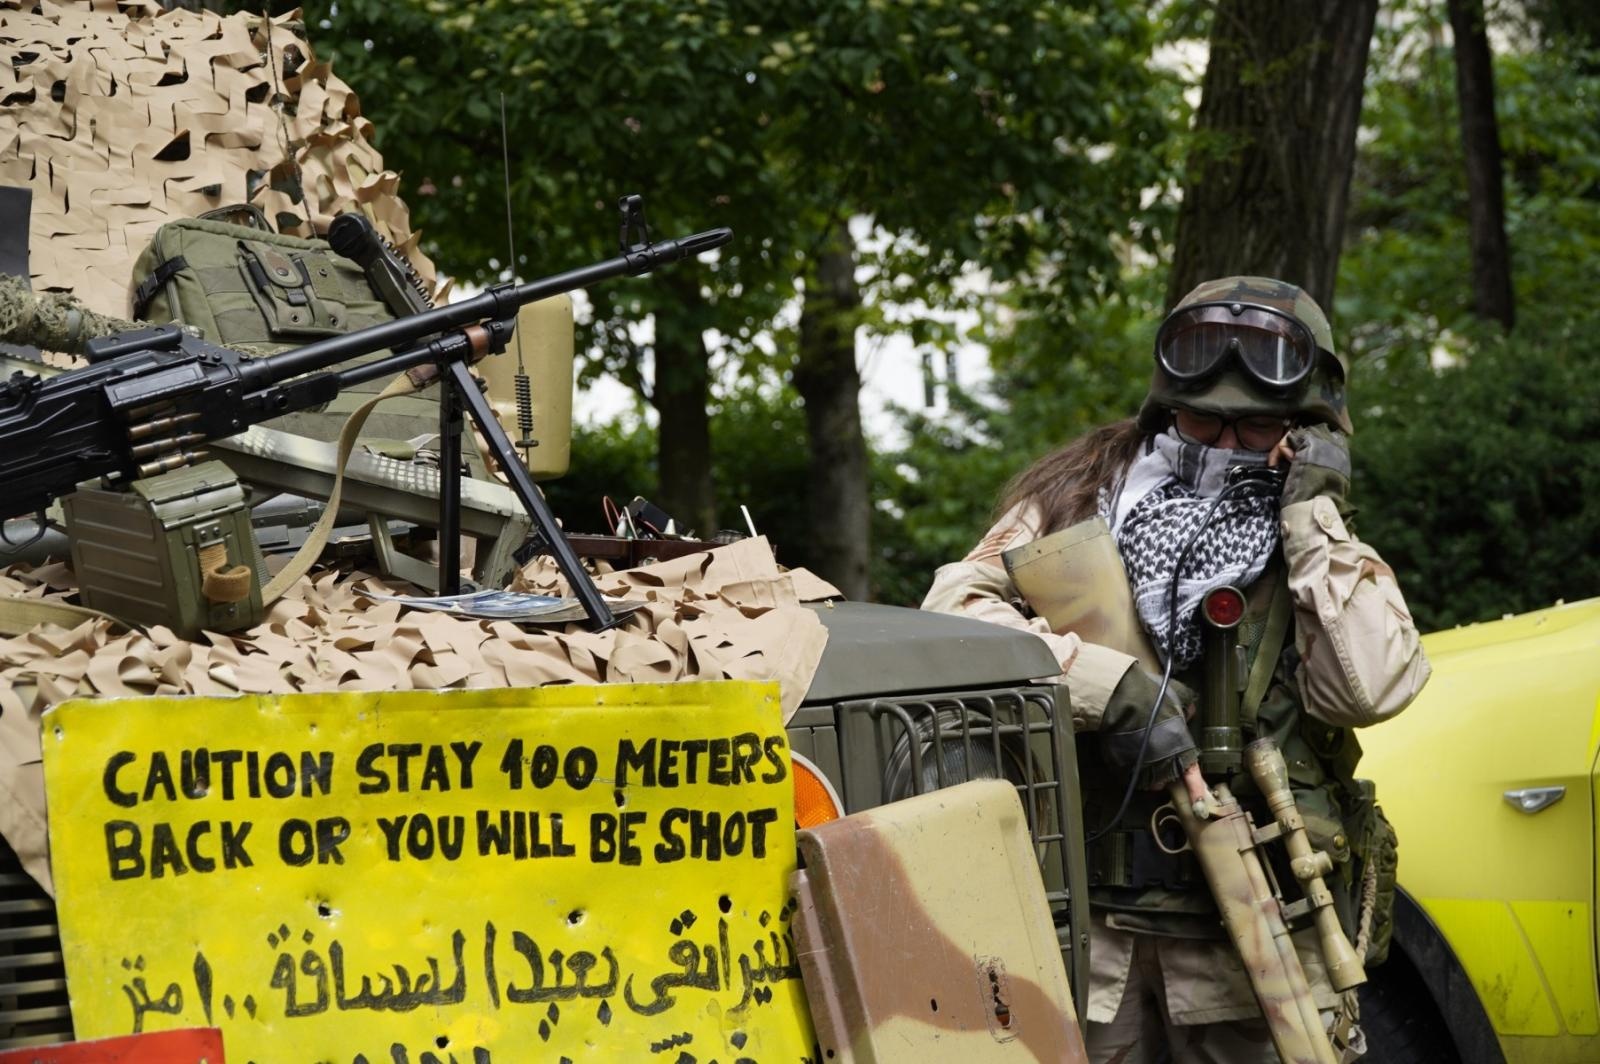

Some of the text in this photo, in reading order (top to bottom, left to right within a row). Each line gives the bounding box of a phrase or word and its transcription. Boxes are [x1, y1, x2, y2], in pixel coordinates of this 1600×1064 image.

[103, 733, 786, 808] CAUTION STAY 100 METERS
[105, 808, 777, 880] BACK OR YOU WILL BE SHOT
[485, 918, 618, 1041] بعيدا
